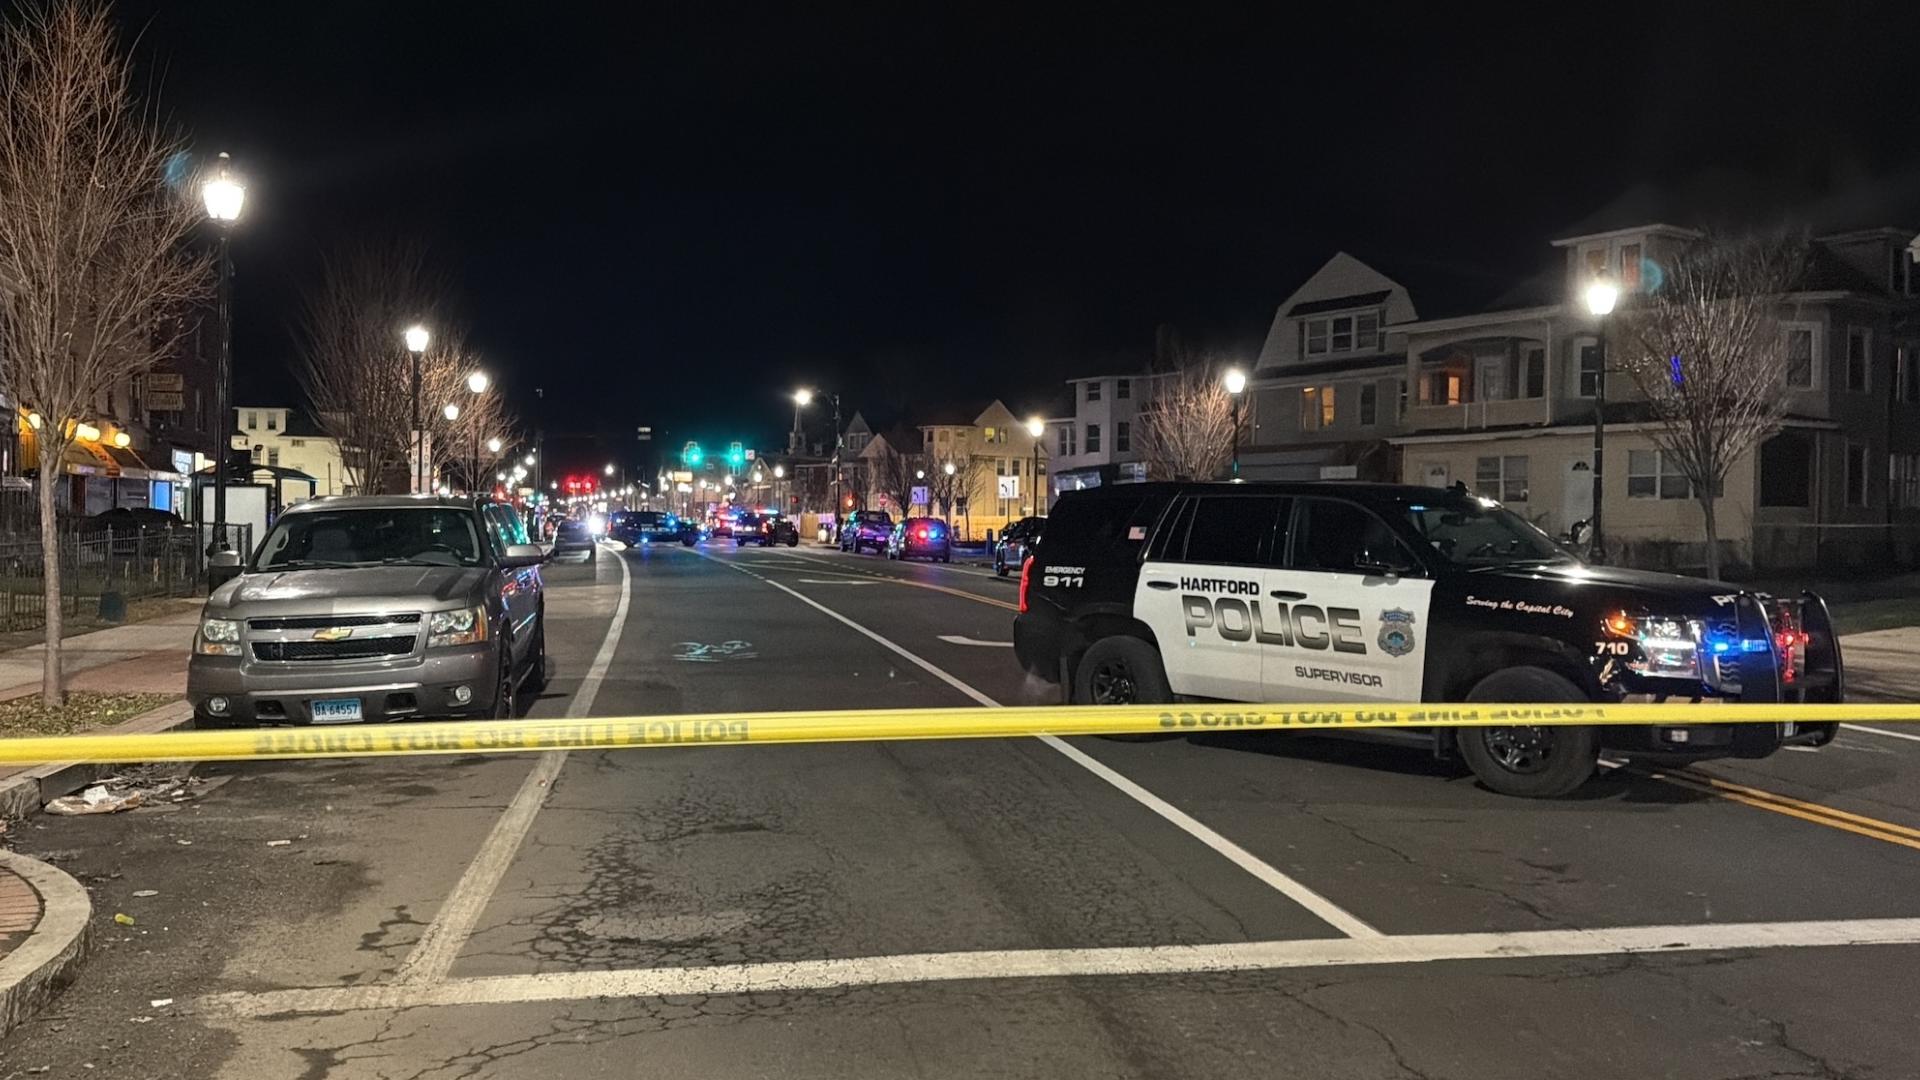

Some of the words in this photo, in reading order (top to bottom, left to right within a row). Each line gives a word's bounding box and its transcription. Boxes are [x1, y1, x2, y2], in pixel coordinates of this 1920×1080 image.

[1043, 575, 1084, 588] 911
[1180, 576, 1260, 596] HARTFORD
[1466, 595, 1498, 610] Serving
[1500, 600, 1513, 609] the
[1515, 601, 1552, 613] Capital
[1553, 605, 1574, 618] City
[1182, 594, 1367, 655] POLICE
[1595, 641, 1628, 655] 710
[1295, 666, 1383, 687] SUPERVISOR
